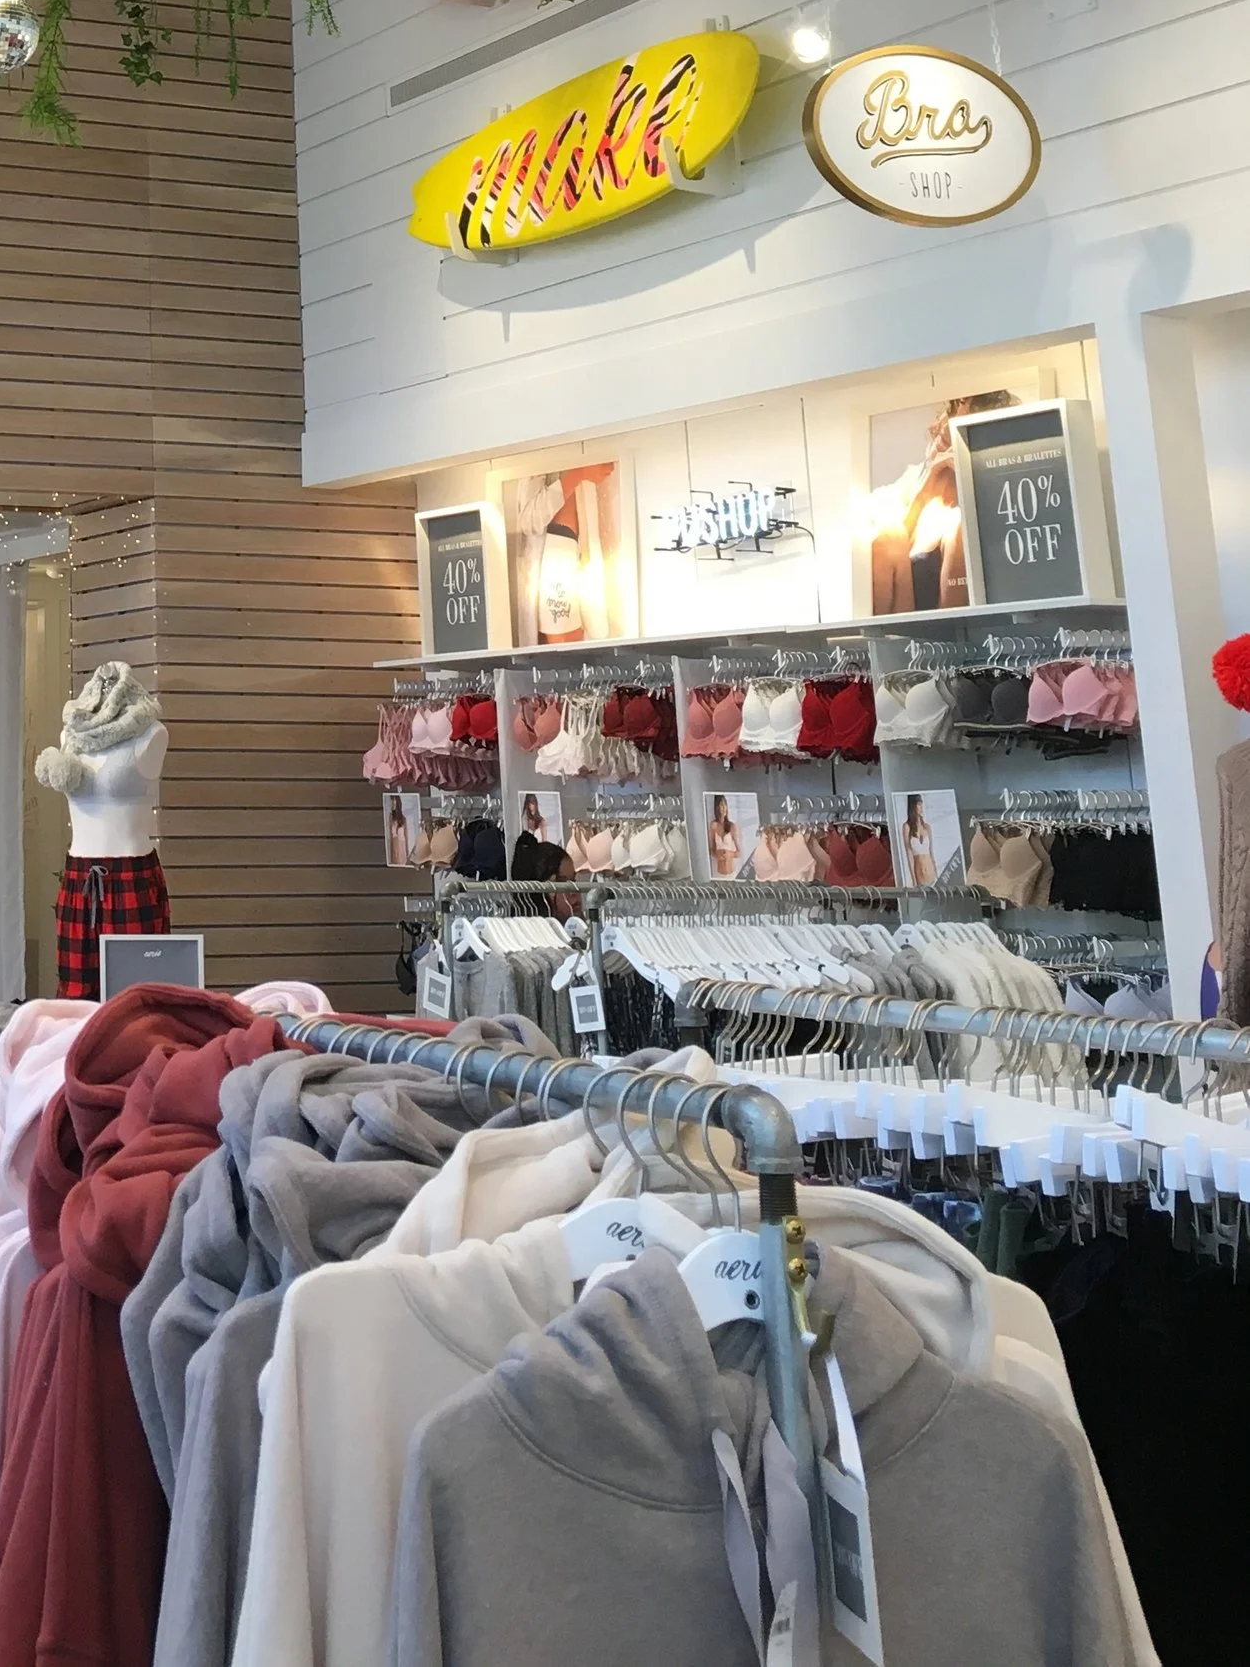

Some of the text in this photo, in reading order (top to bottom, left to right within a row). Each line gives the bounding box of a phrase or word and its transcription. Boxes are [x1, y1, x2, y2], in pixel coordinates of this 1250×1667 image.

[856, 70, 993, 168] Bra
[910, 171, 953, 200] SHOP
[985, 459, 997, 469] ALL
[998, 457, 1016, 467] BRAS
[1023, 449, 1062, 463] BRALETTES
[997, 474, 1061, 525] 40%
[1004, 523, 1062, 565] OFF
[442, 557, 481, 596] 40%
[446, 595, 481, 625] OFF
[606, 1221, 645, 1248] aer
[714, 1259, 762, 1281] aeri
